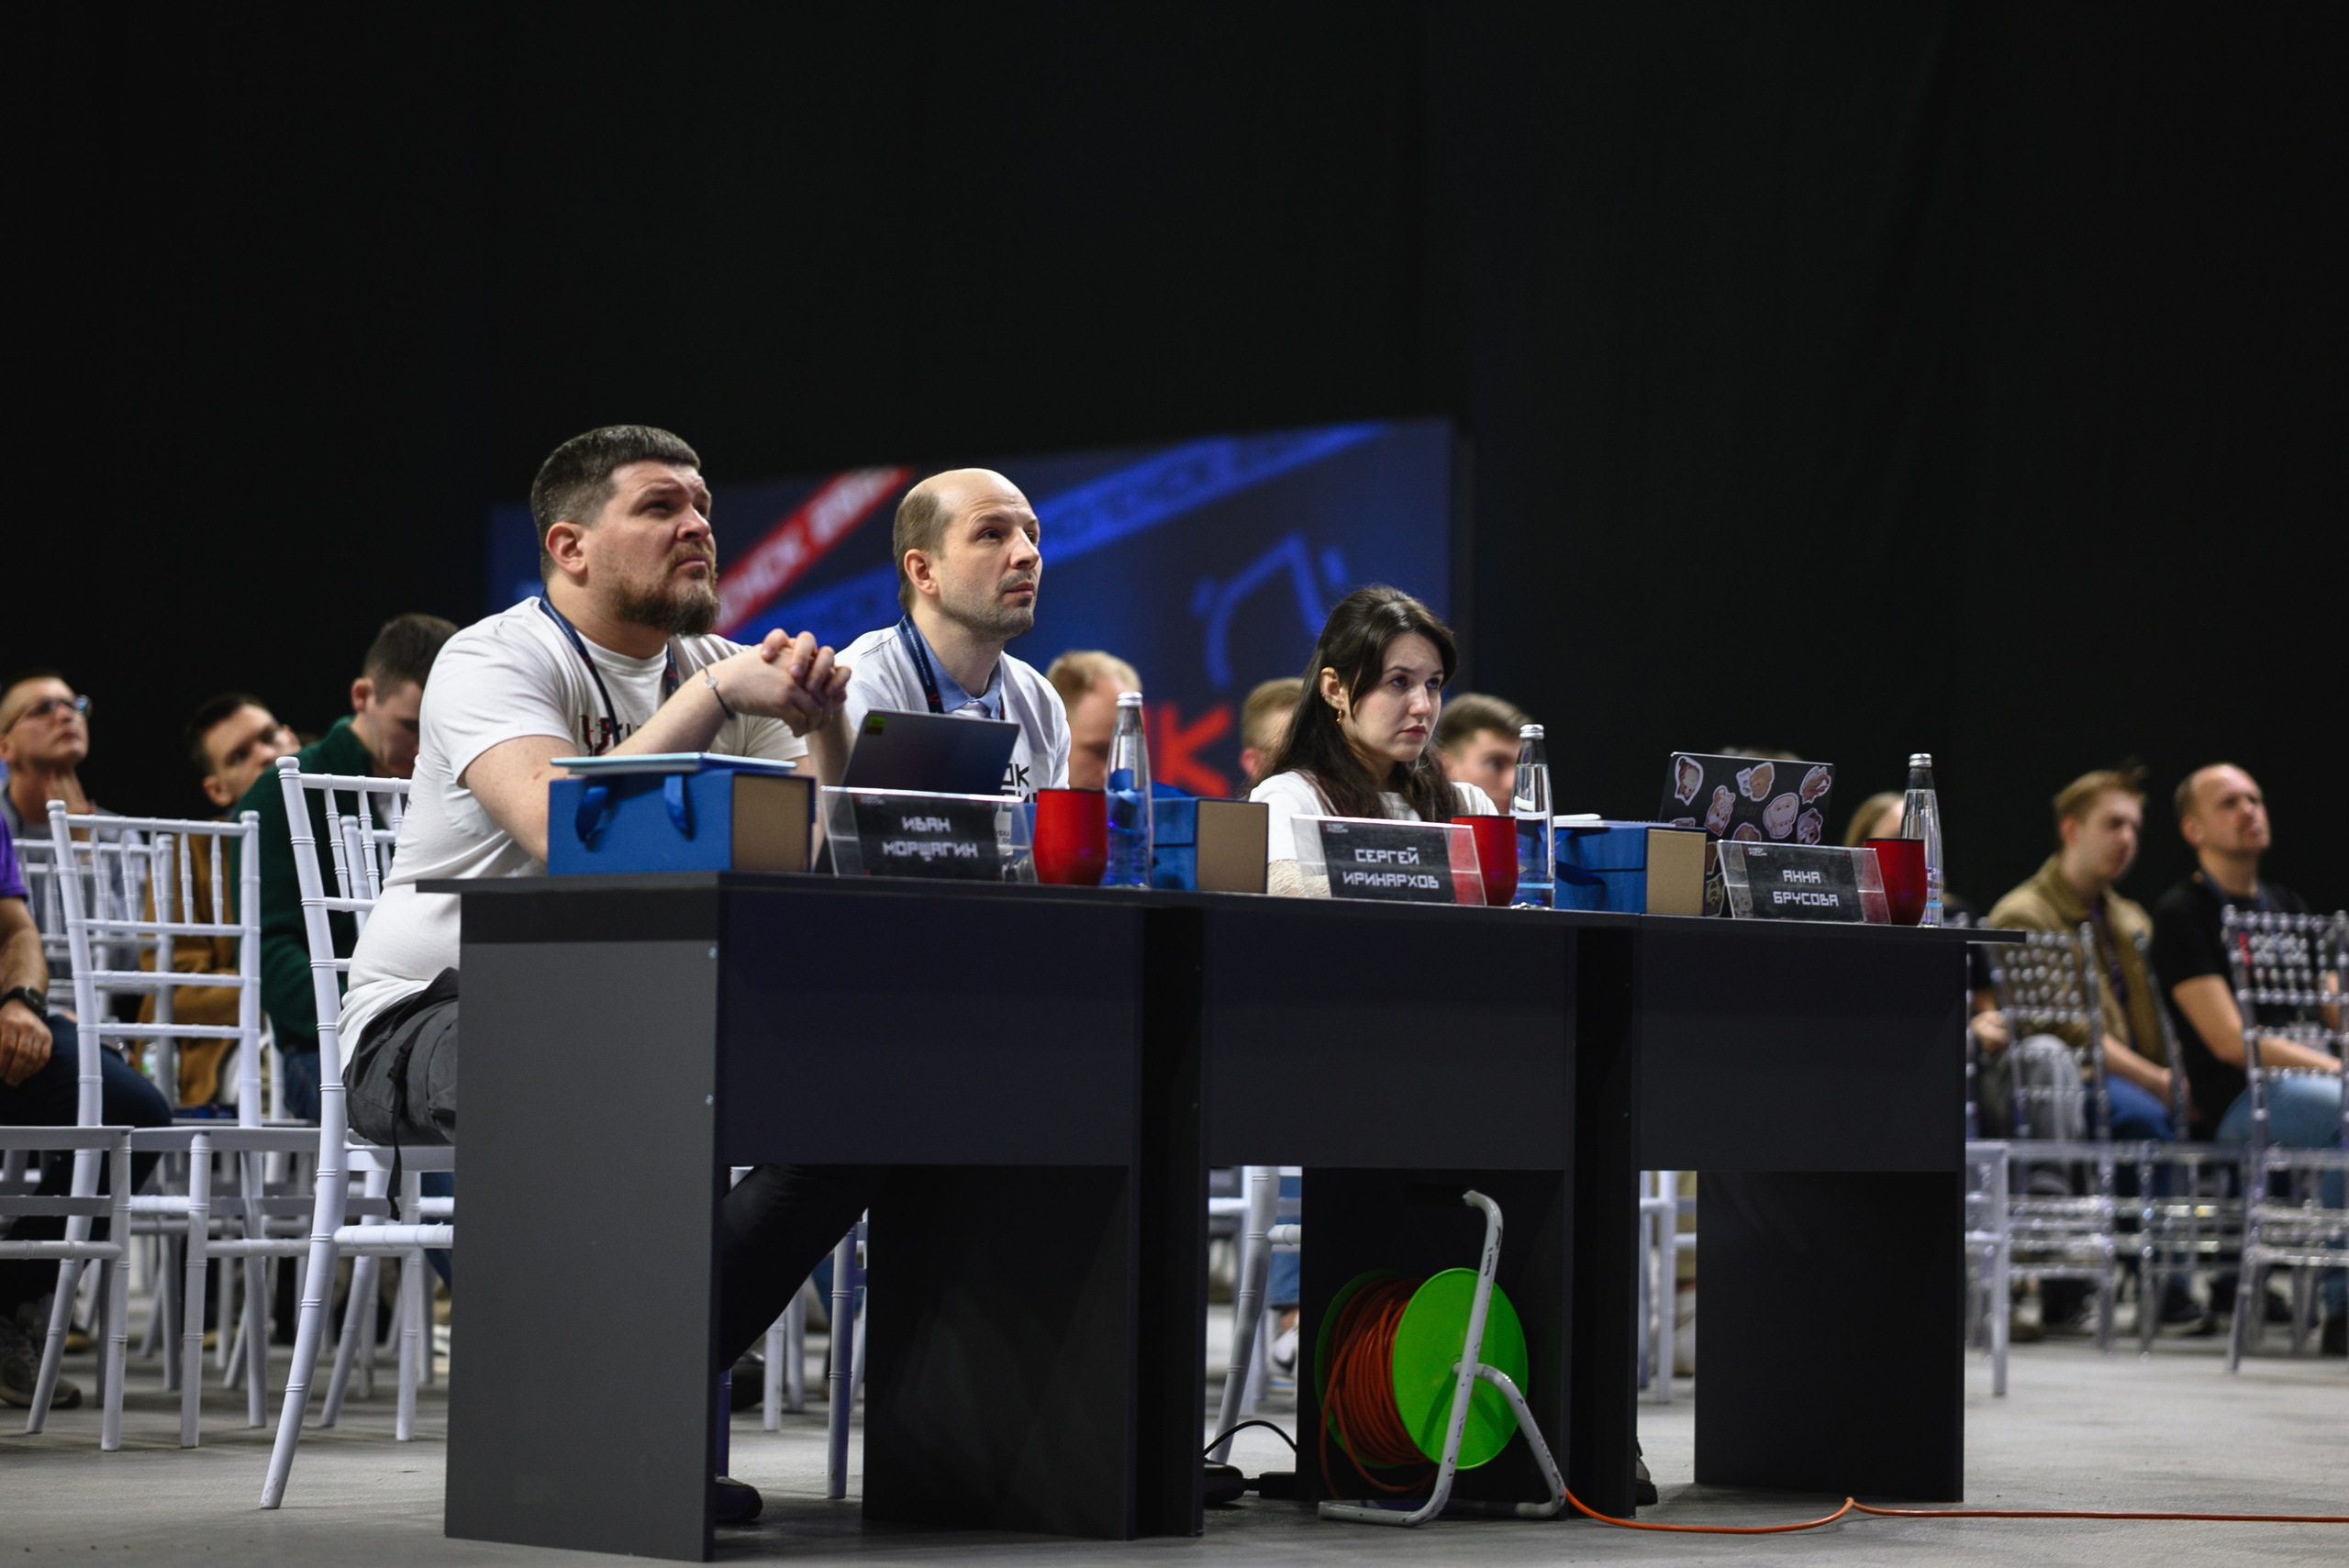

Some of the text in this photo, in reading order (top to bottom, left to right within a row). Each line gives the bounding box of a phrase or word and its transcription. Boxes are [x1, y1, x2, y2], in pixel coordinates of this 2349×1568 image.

[901, 815, 952, 833] ИВАН
[1354, 846, 1420, 865] СЕРГЕЙ
[1342, 872, 1440, 890] ИРИНАРХОВ
[1782, 869, 1821, 884] АННА
[1772, 890, 1840, 907] БРУСОВА
